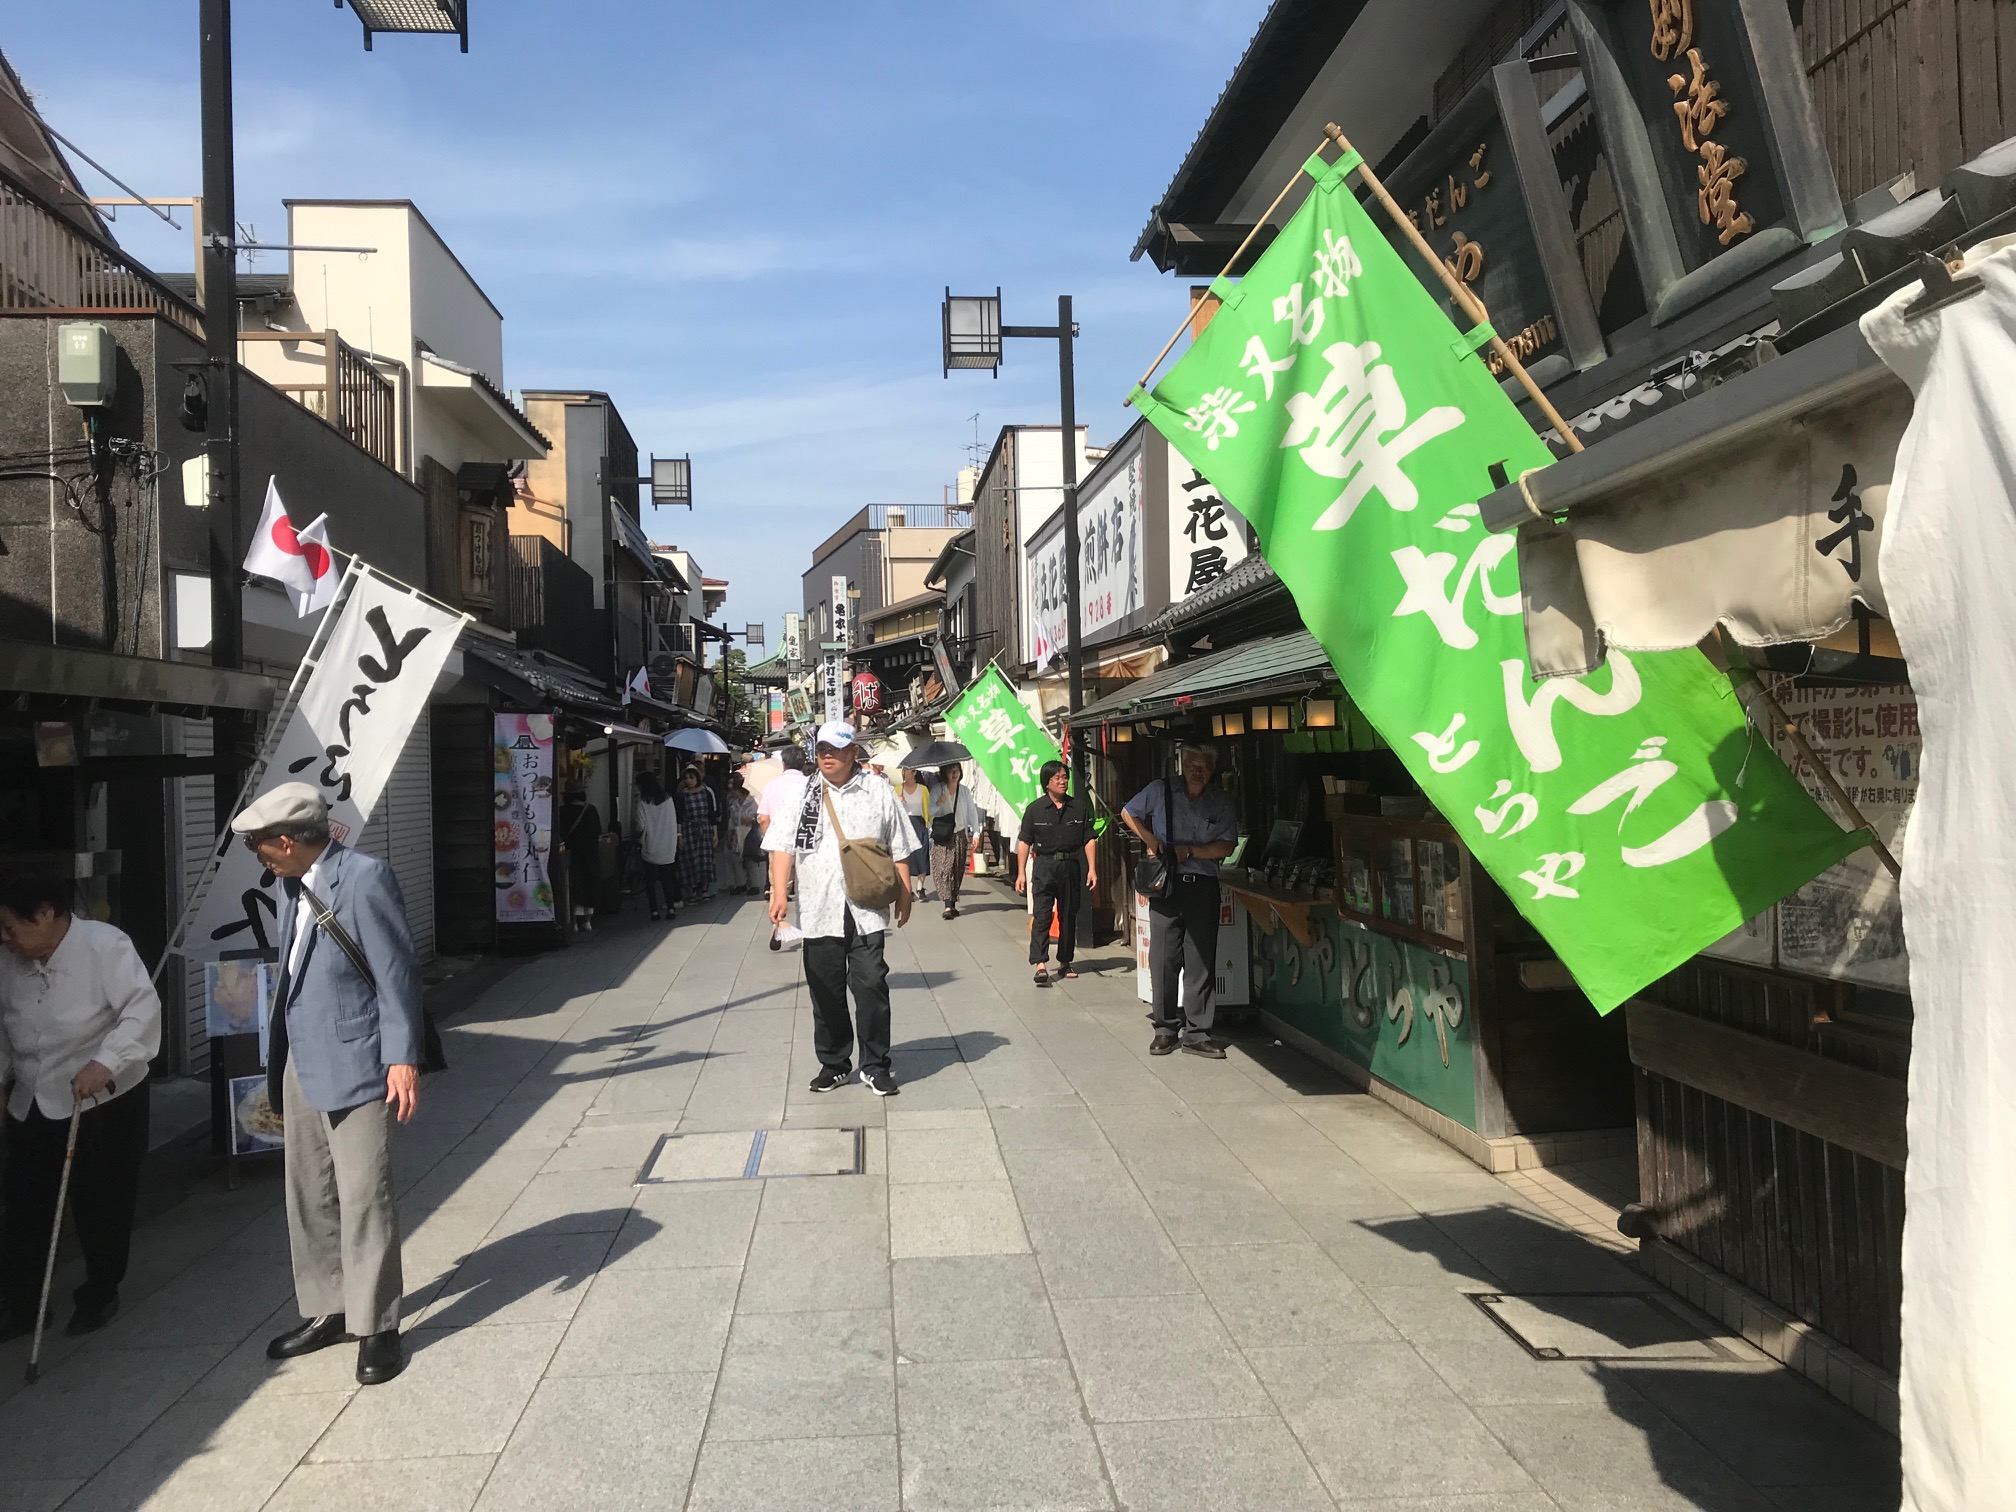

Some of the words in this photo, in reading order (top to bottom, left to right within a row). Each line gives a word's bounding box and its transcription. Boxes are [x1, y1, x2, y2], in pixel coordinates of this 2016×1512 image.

[1183, 228, 1364, 450] 柴又名物
[1280, 341, 1738, 868] 草だんご
[1815, 464, 1874, 583] 手
[522, 753, 541, 883] おつけもの丸仁
[1411, 713, 1586, 900] とらや
